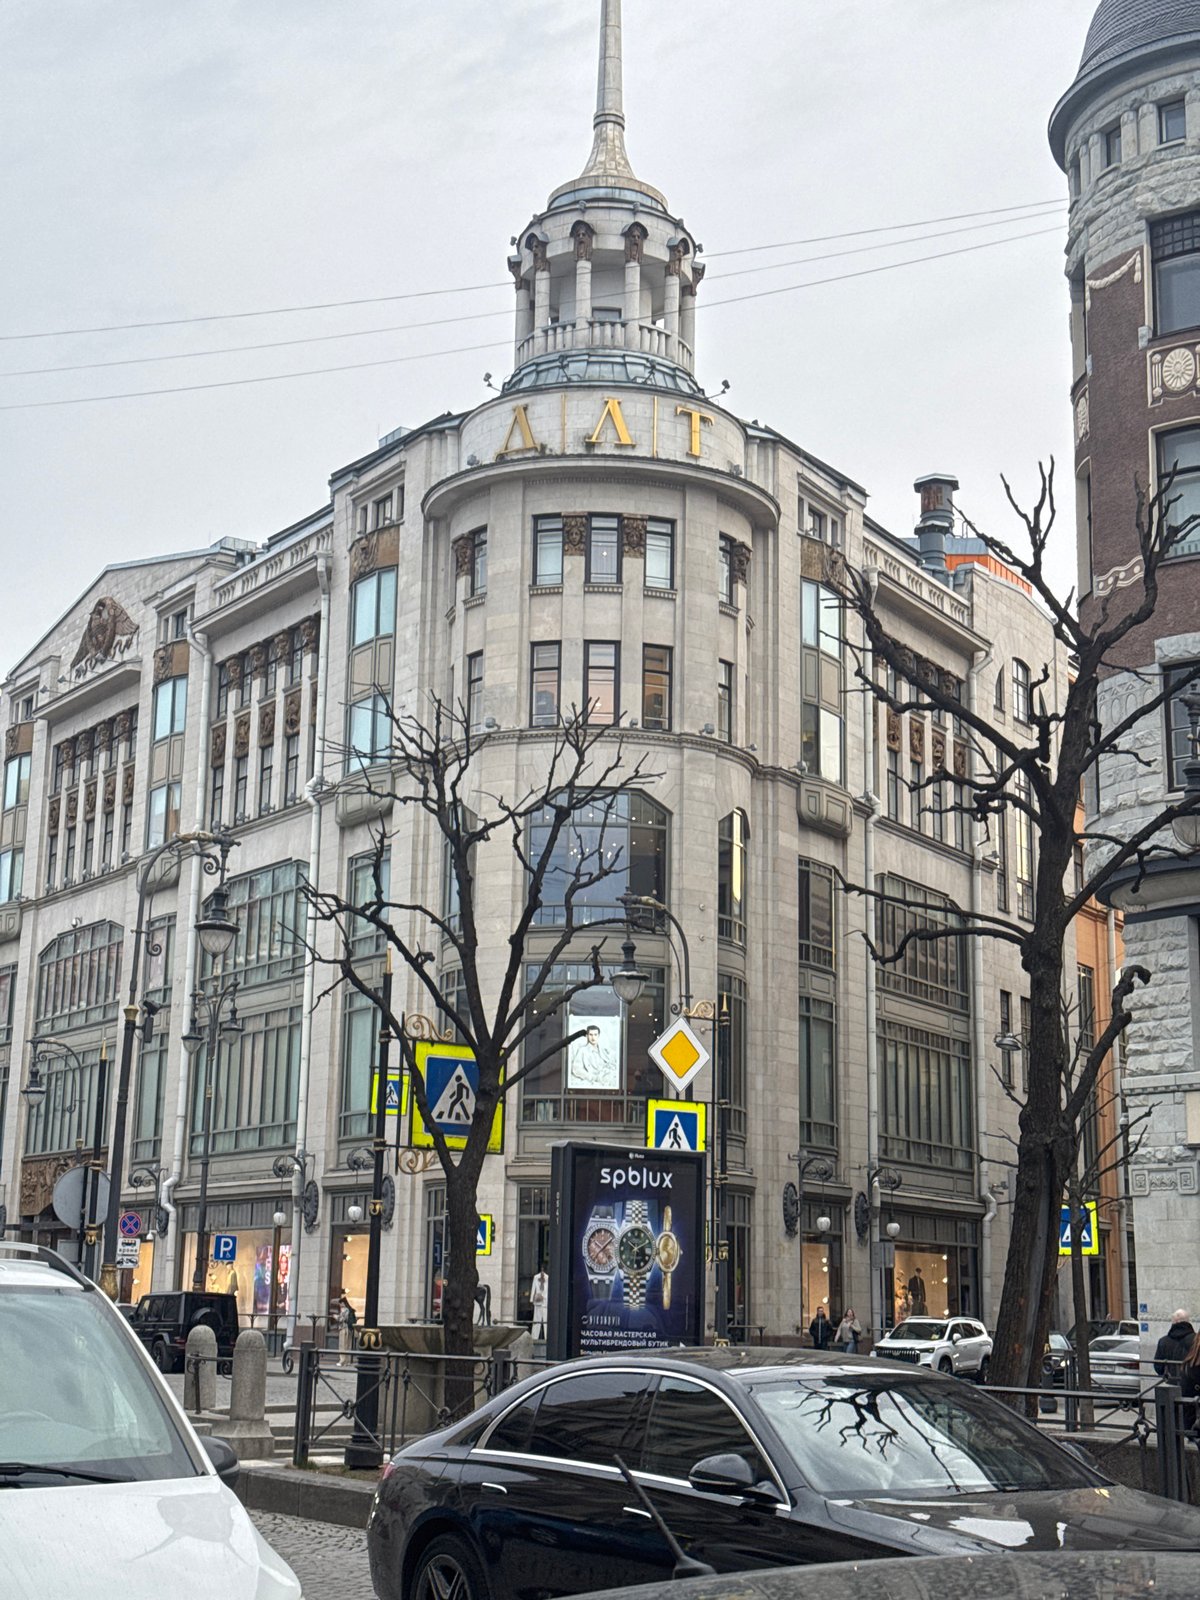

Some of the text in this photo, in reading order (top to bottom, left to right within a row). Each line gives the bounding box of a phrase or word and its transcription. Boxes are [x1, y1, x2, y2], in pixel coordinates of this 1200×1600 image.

[600, 1166, 673, 1190] spblux
[219, 1237, 233, 1258] P
[581, 1330, 657, 1339] ЧАСОВАЯ МАСТЕРСКАЯ
[580, 1339, 647, 1347] МУЛЬТИБРЕНДОВЫЙ
